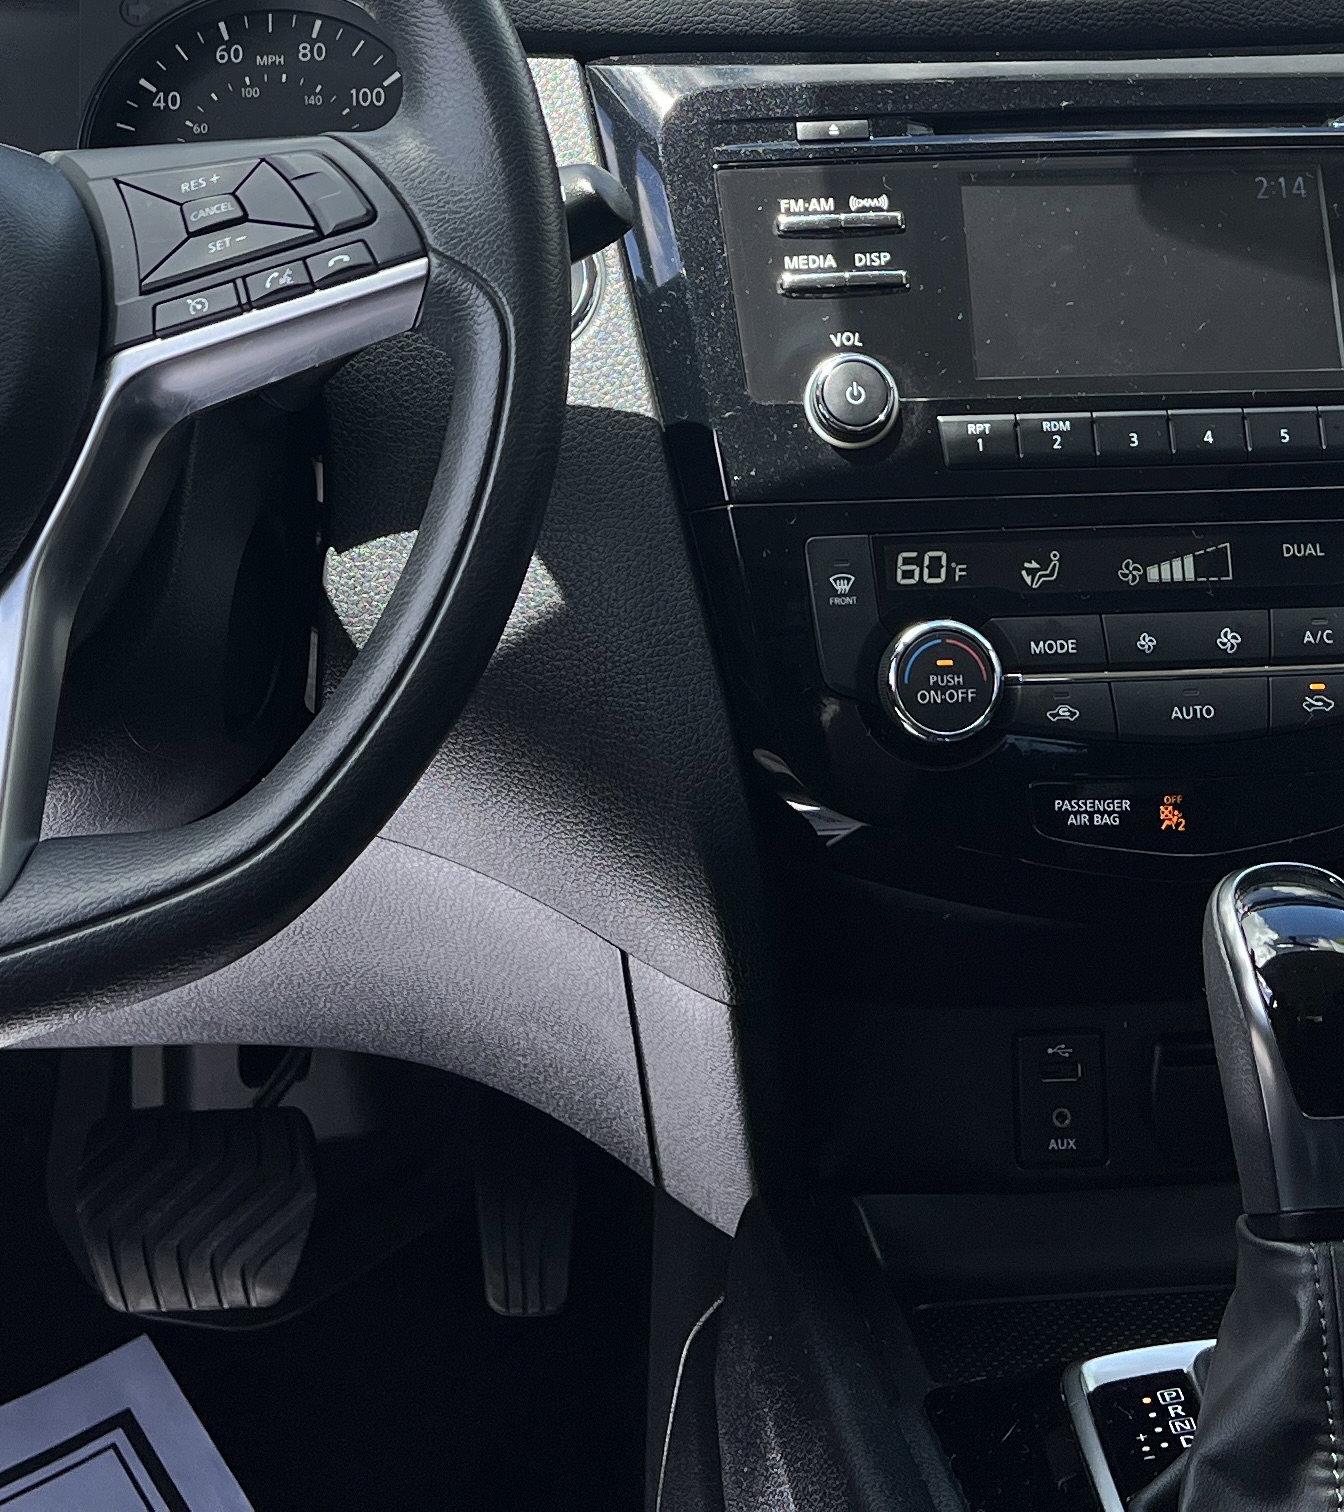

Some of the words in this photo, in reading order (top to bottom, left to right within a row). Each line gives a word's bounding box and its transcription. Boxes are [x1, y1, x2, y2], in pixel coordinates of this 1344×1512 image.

[215, 44, 244, 64] 60
[298, 42, 327, 61] 80
[256, 55, 285, 67] MPH
[240, 87, 260, 98] 100
[350, 88, 385, 106] 100
[152, 91, 181, 110] 40
[304, 95, 323, 106] 140
[193, 123, 208, 134] 60
[180, 178, 207, 193] RES
[1255, 176, 1307, 199] 2:14
[190, 201, 235, 222] CANCEL
[208, 237, 232, 254] SET
[784, 254, 837, 269] MEDIA
[855, 252, 891, 267] DISP
[829, 332, 863, 347] VOL
[967, 423, 991, 435] RPT
[1042, 420, 1071, 432] RDM
[1052, 435, 1062, 449] 2
[1129, 433, 1139, 447] 3
[1203, 430, 1214, 444] 4
[1280, 428, 1290, 443] 5
[976, 438, 984, 452] 1
[1283, 543, 1325, 557] DUAL
[829, 596, 857, 606] FRONT
[1303, 629, 1334, 645] A/C
[1030, 641, 1077, 655] MODE
[929, 675, 963, 686] PUSH
[1171, 705, 1215, 720] AUTO
[1054, 800, 1131, 812] PASSENGER
[1163, 795, 1183, 805] OFF
[1067, 814, 1090, 826] AIR
[1093, 814, 1120, 826] BAG
[1049, 1139, 1077, 1150] AUX
[1167, 1405, 1186, 1418] R
